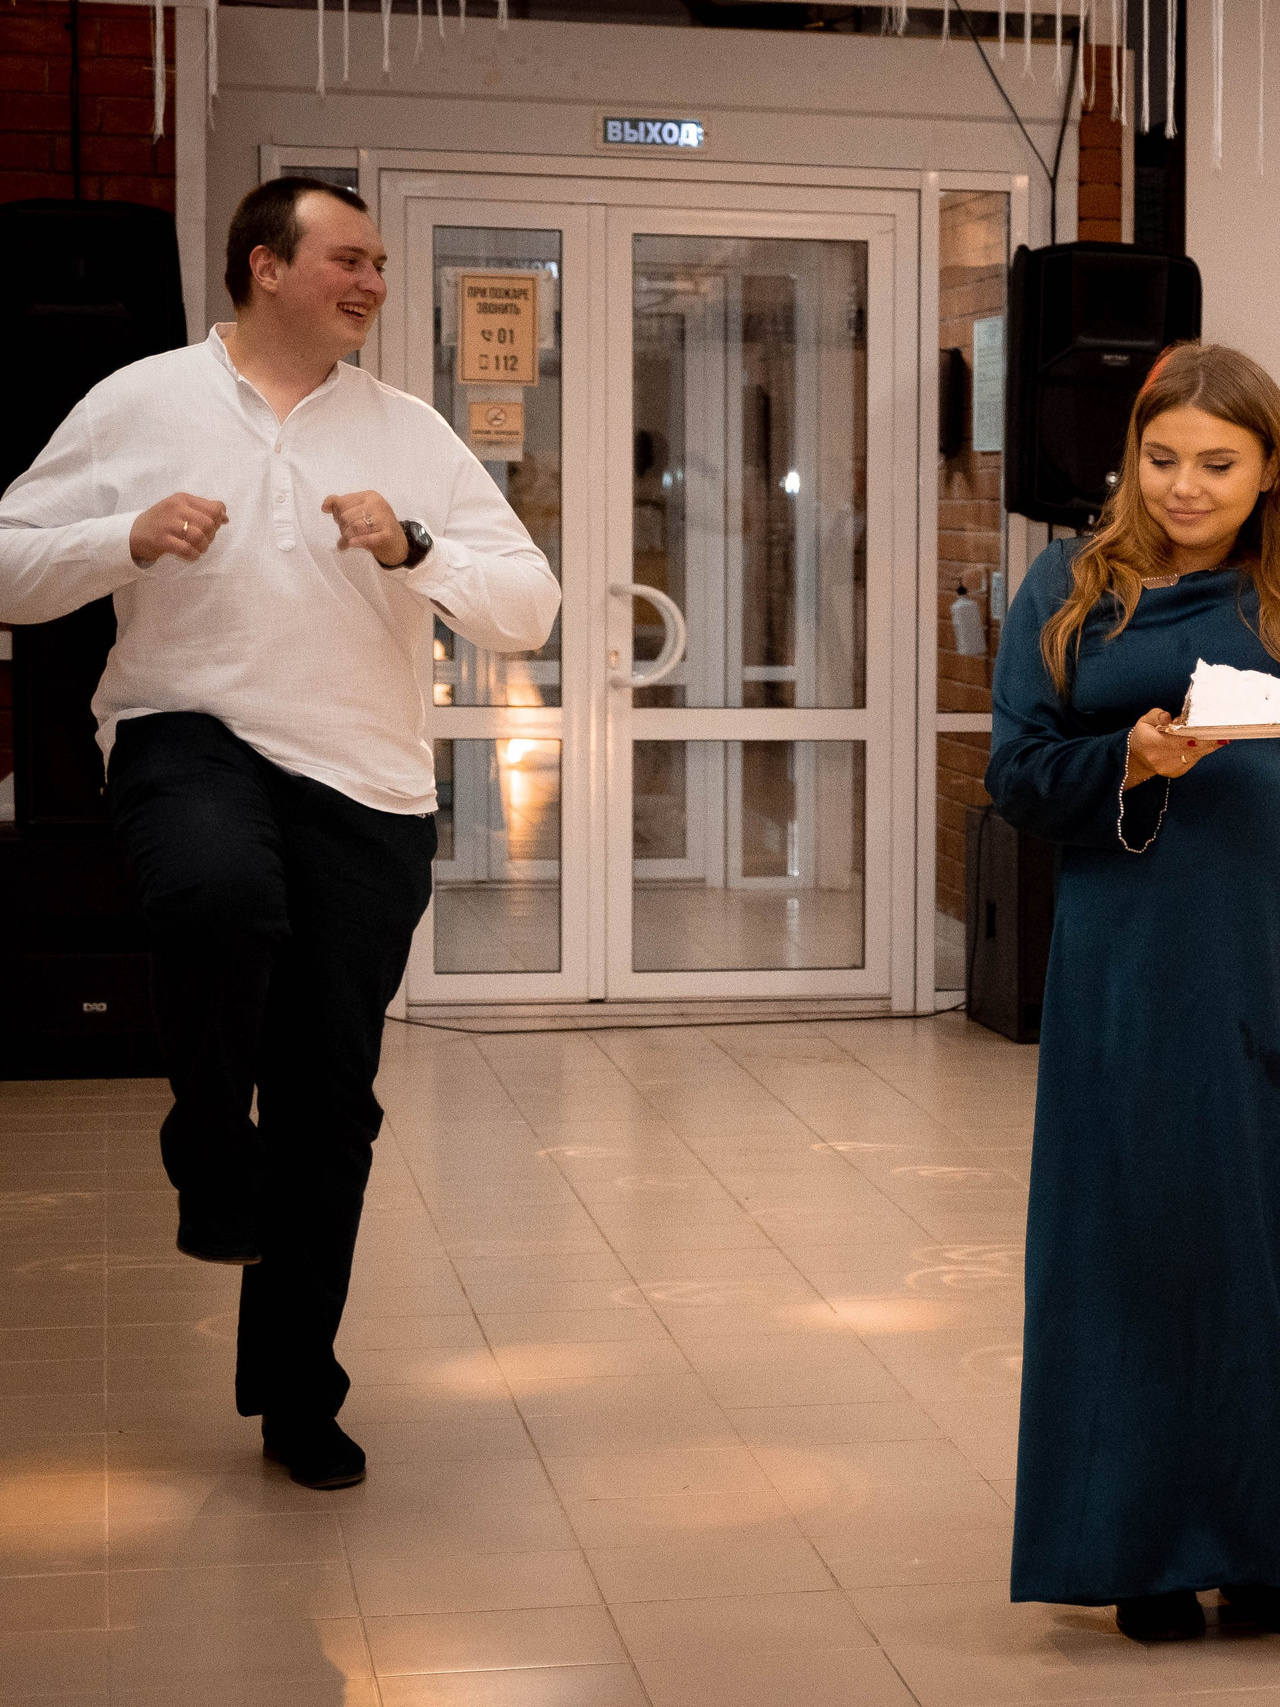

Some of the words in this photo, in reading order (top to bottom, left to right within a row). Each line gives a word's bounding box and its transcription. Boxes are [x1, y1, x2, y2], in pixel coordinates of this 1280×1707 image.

[606, 120, 699, 147] ВЫХОД
[467, 286, 487, 298] ПРИ
[489, 287, 528, 300] ПОЖАРЕ
[476, 302, 521, 314] ЗВОНИТЬ
[497, 328, 514, 344] 01
[495, 355, 518, 370] 112
